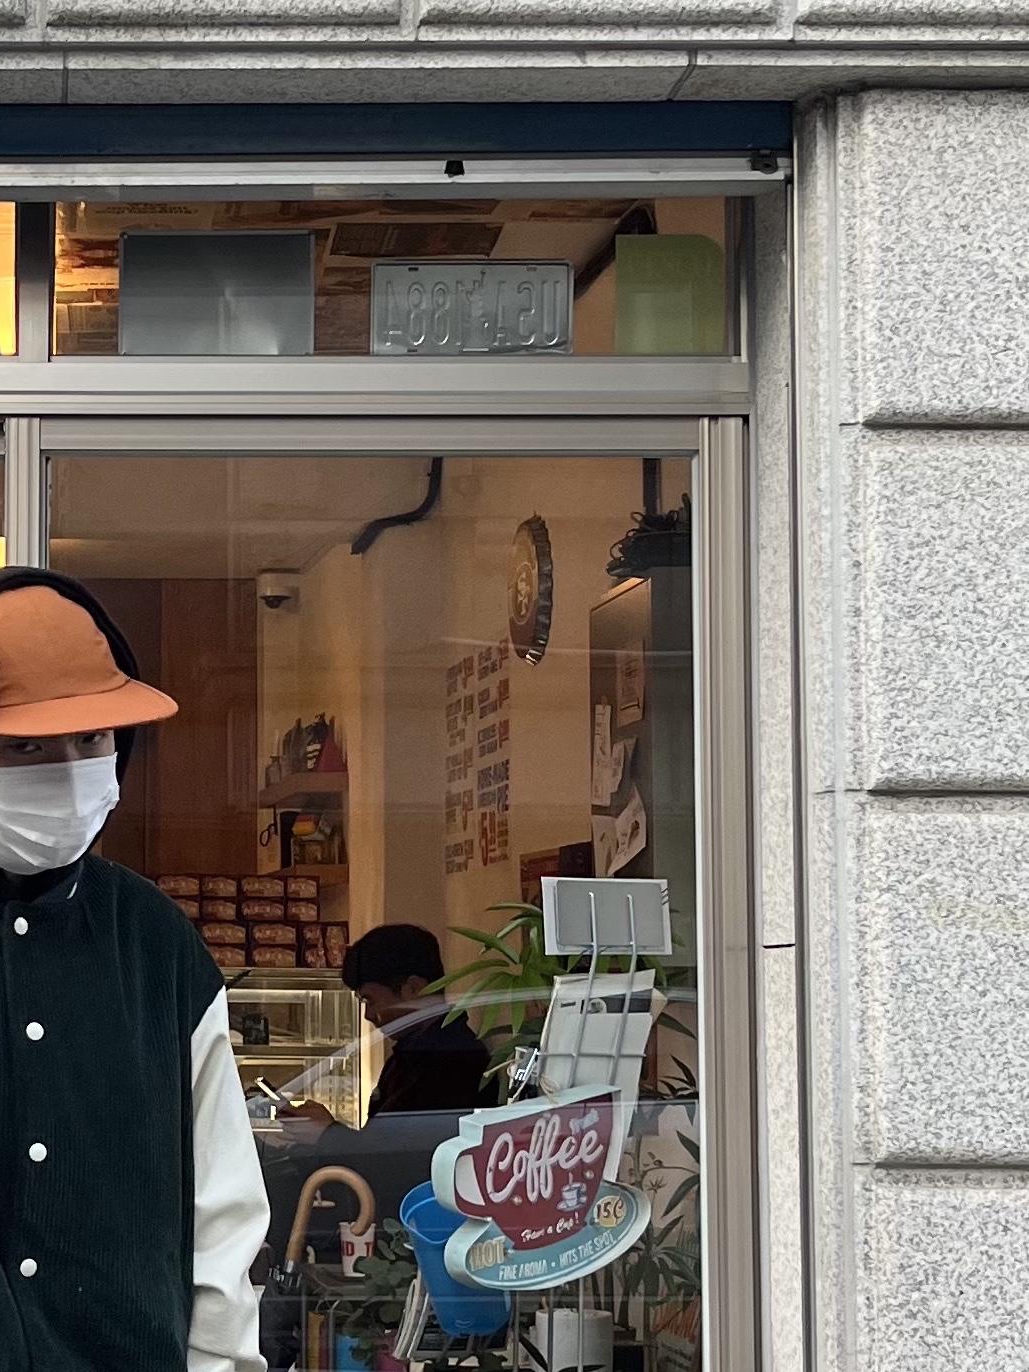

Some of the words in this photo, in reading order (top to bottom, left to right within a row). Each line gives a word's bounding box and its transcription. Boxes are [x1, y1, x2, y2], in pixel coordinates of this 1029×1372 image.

[485, 1114, 604, 1204] Coffee
[470, 1236, 507, 1271] HOT
[559, 1248, 578, 1266] HITS
[577, 1240, 595, 1258] THE
